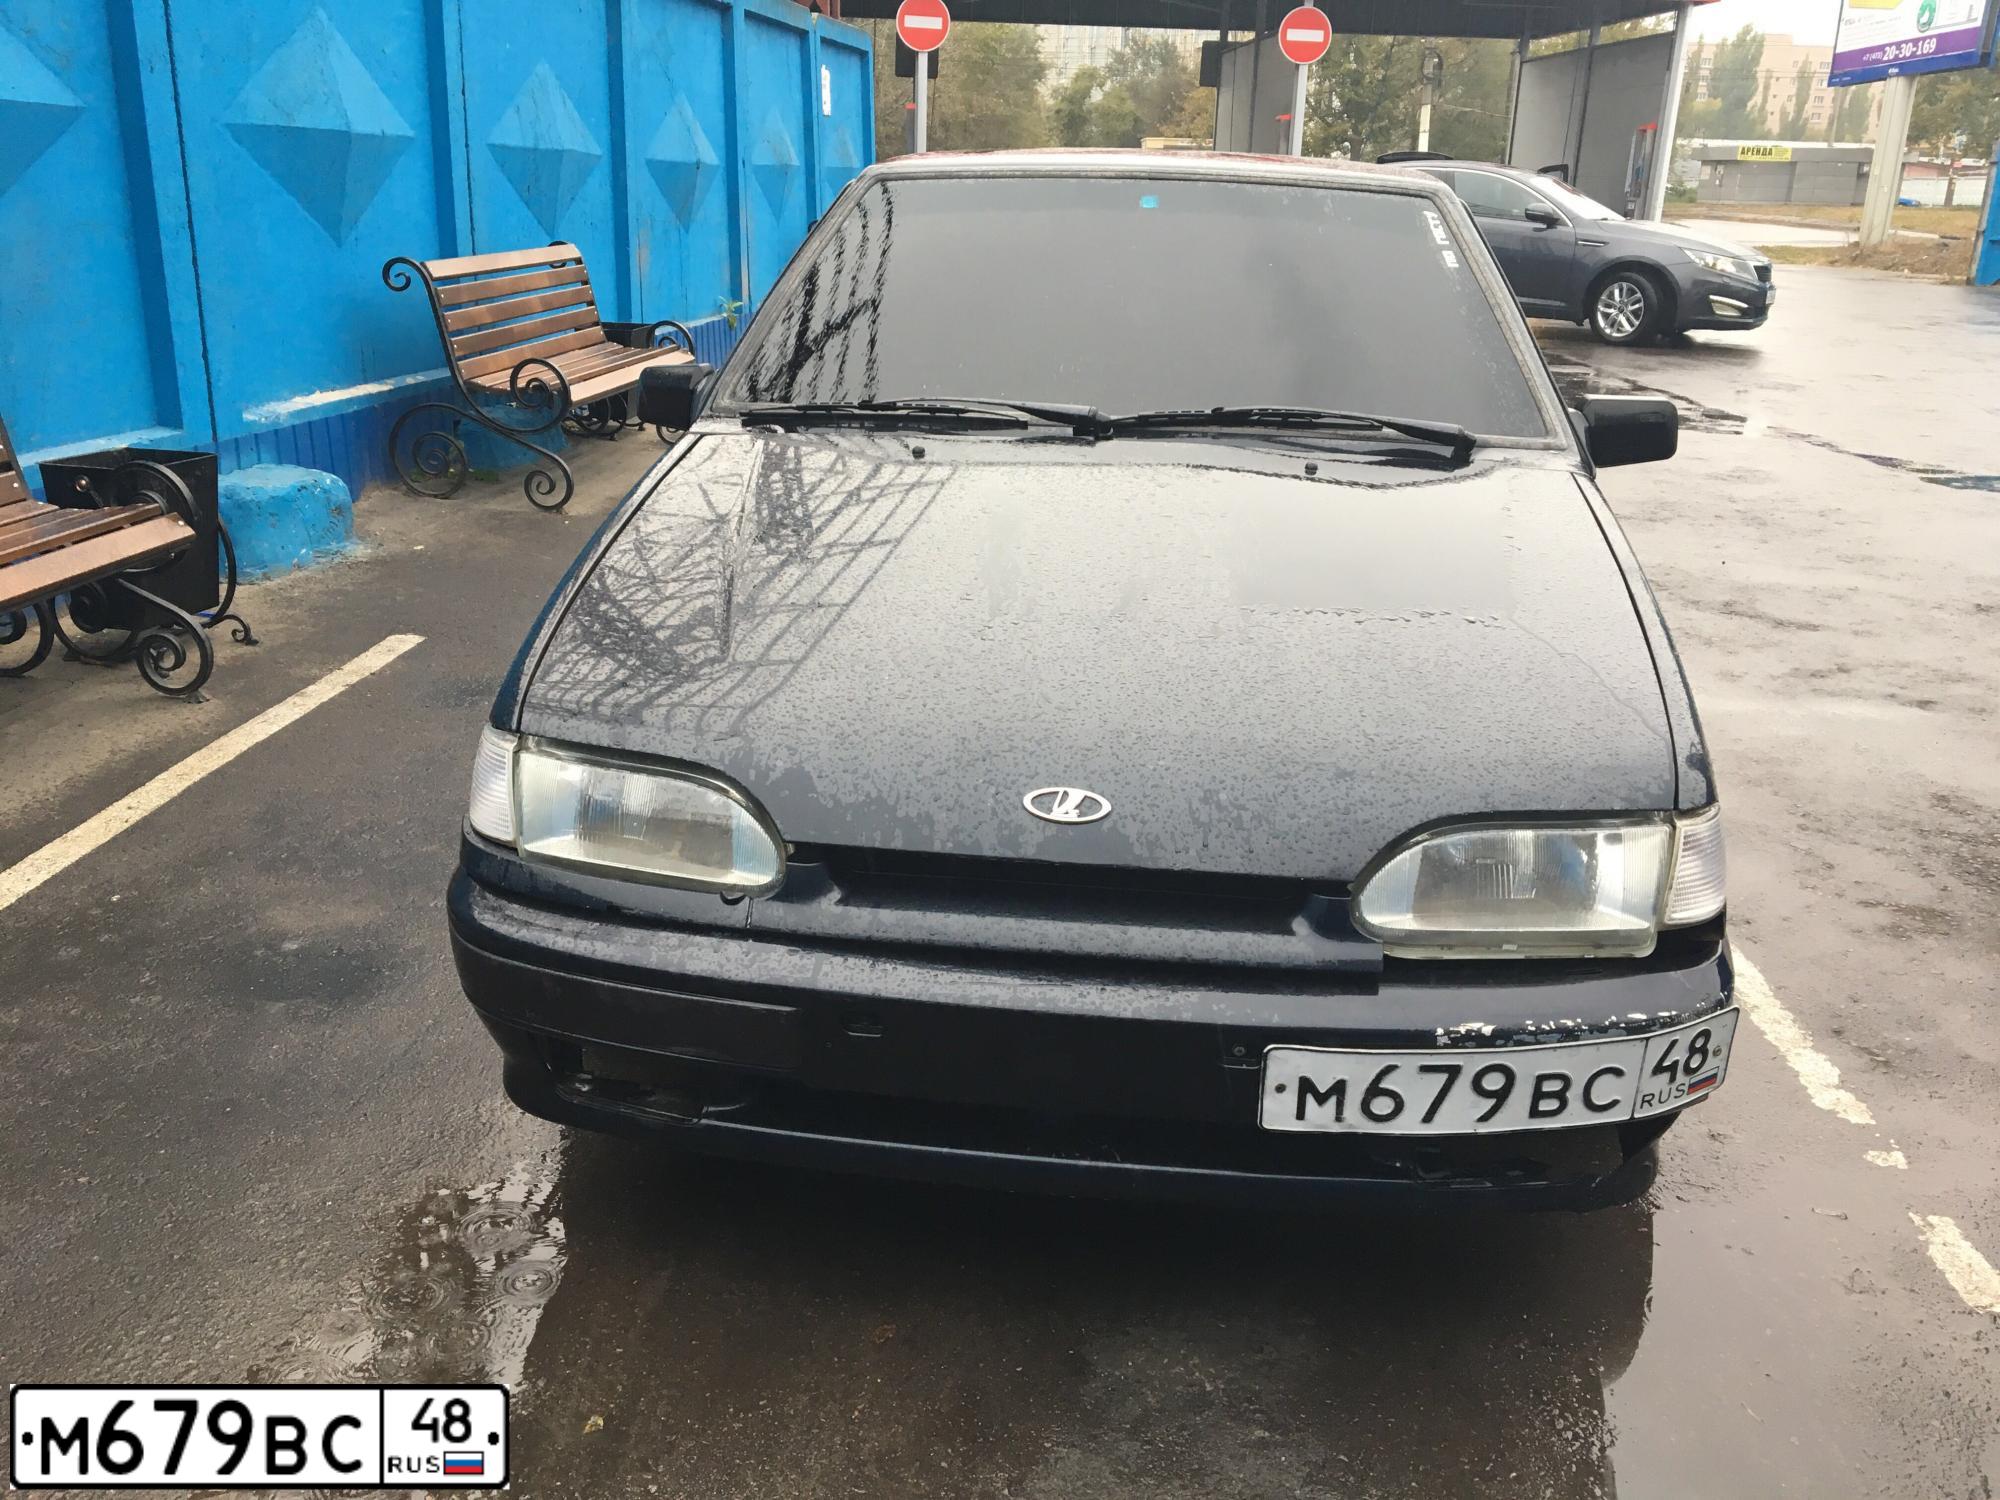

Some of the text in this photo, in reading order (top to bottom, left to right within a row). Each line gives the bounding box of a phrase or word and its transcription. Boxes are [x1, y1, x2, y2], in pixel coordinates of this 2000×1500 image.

[1883, 37, 1937, 61] 20-30-169
[1740, 147, 1773, 156] АРЕНДА
[1652, 1028, 1711, 1083] 48
[1640, 1083, 1686, 1110] RUS
